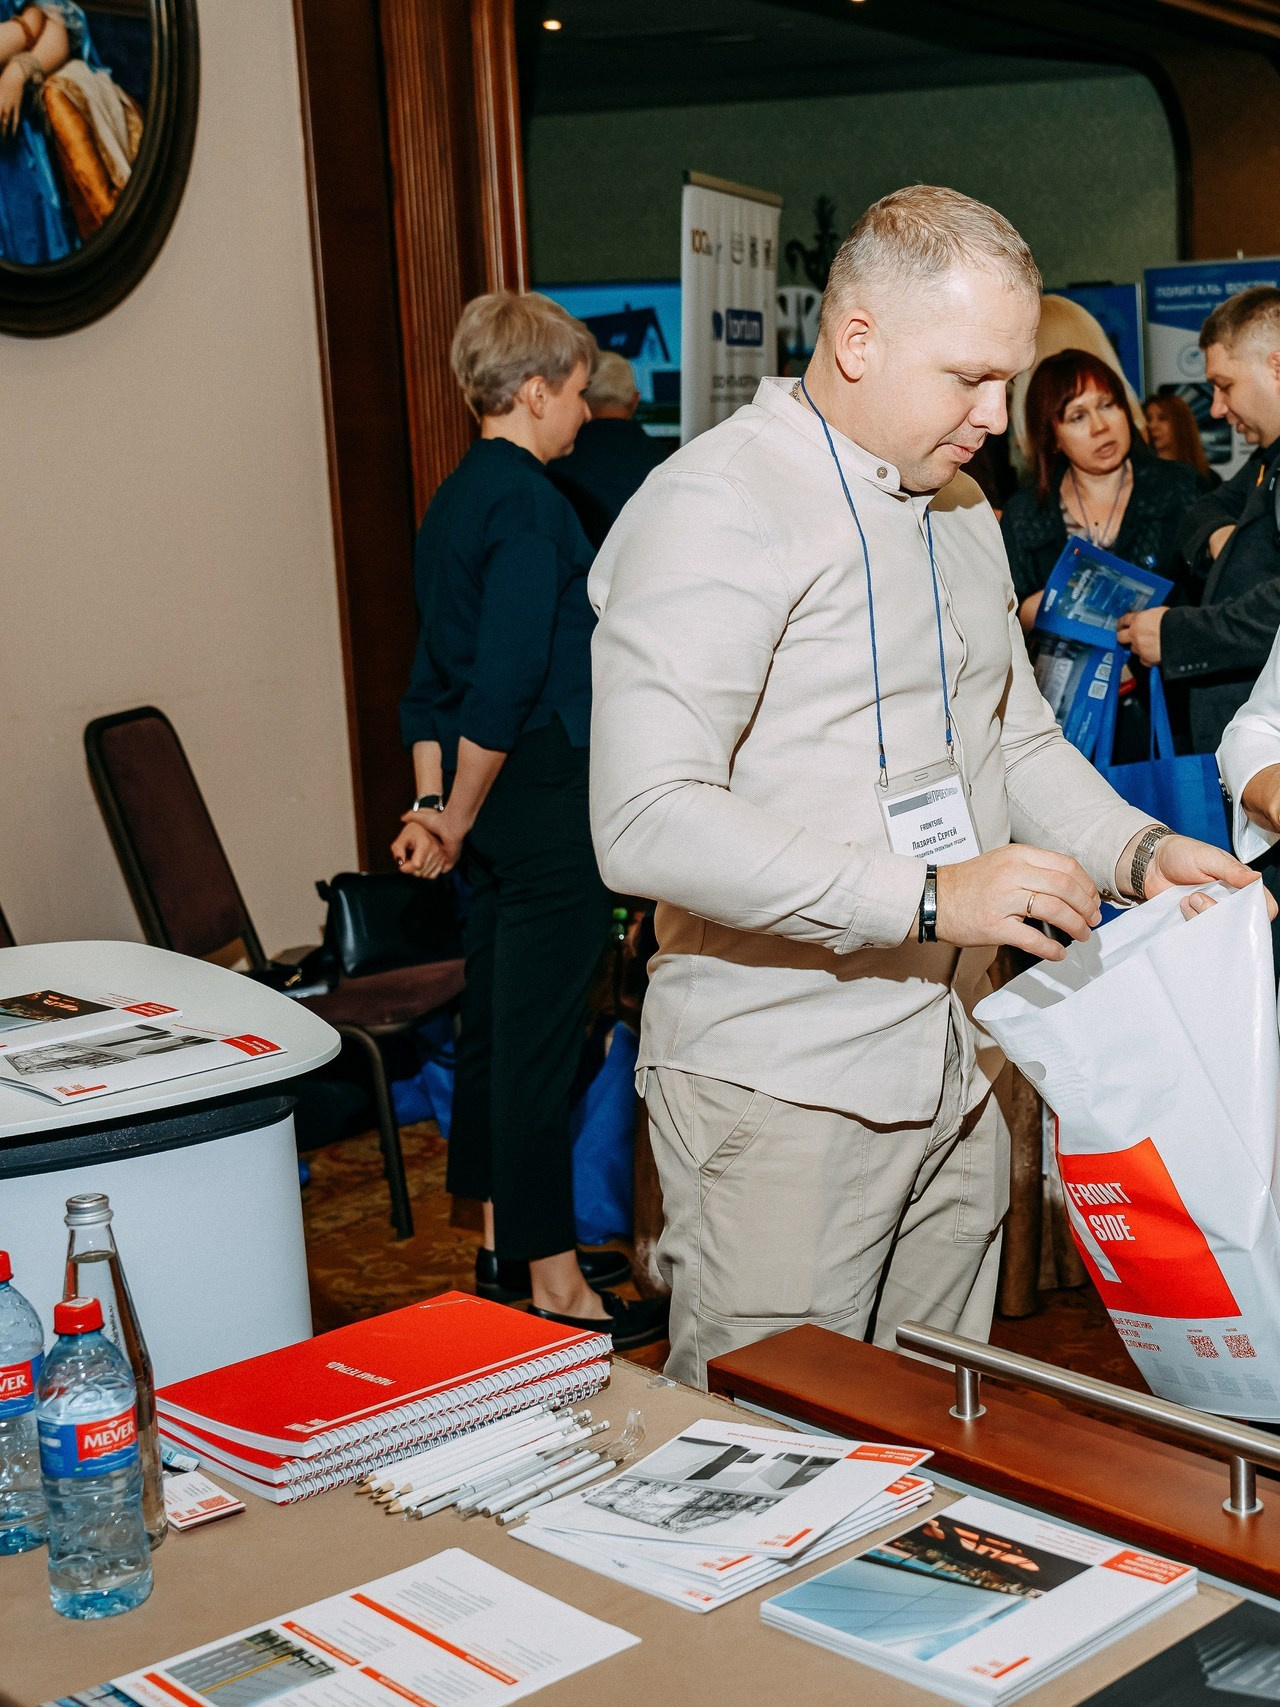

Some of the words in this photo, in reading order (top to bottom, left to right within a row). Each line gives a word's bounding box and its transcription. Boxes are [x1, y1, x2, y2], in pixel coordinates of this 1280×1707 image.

[920, 817, 944, 831] FRONTSIDE
[1066, 1182, 1132, 1206] FRONT
[1088, 1214, 1136, 1241] SIDE
[0, 1374, 28, 1393] VER
[83, 1421, 135, 1449] MEVER
